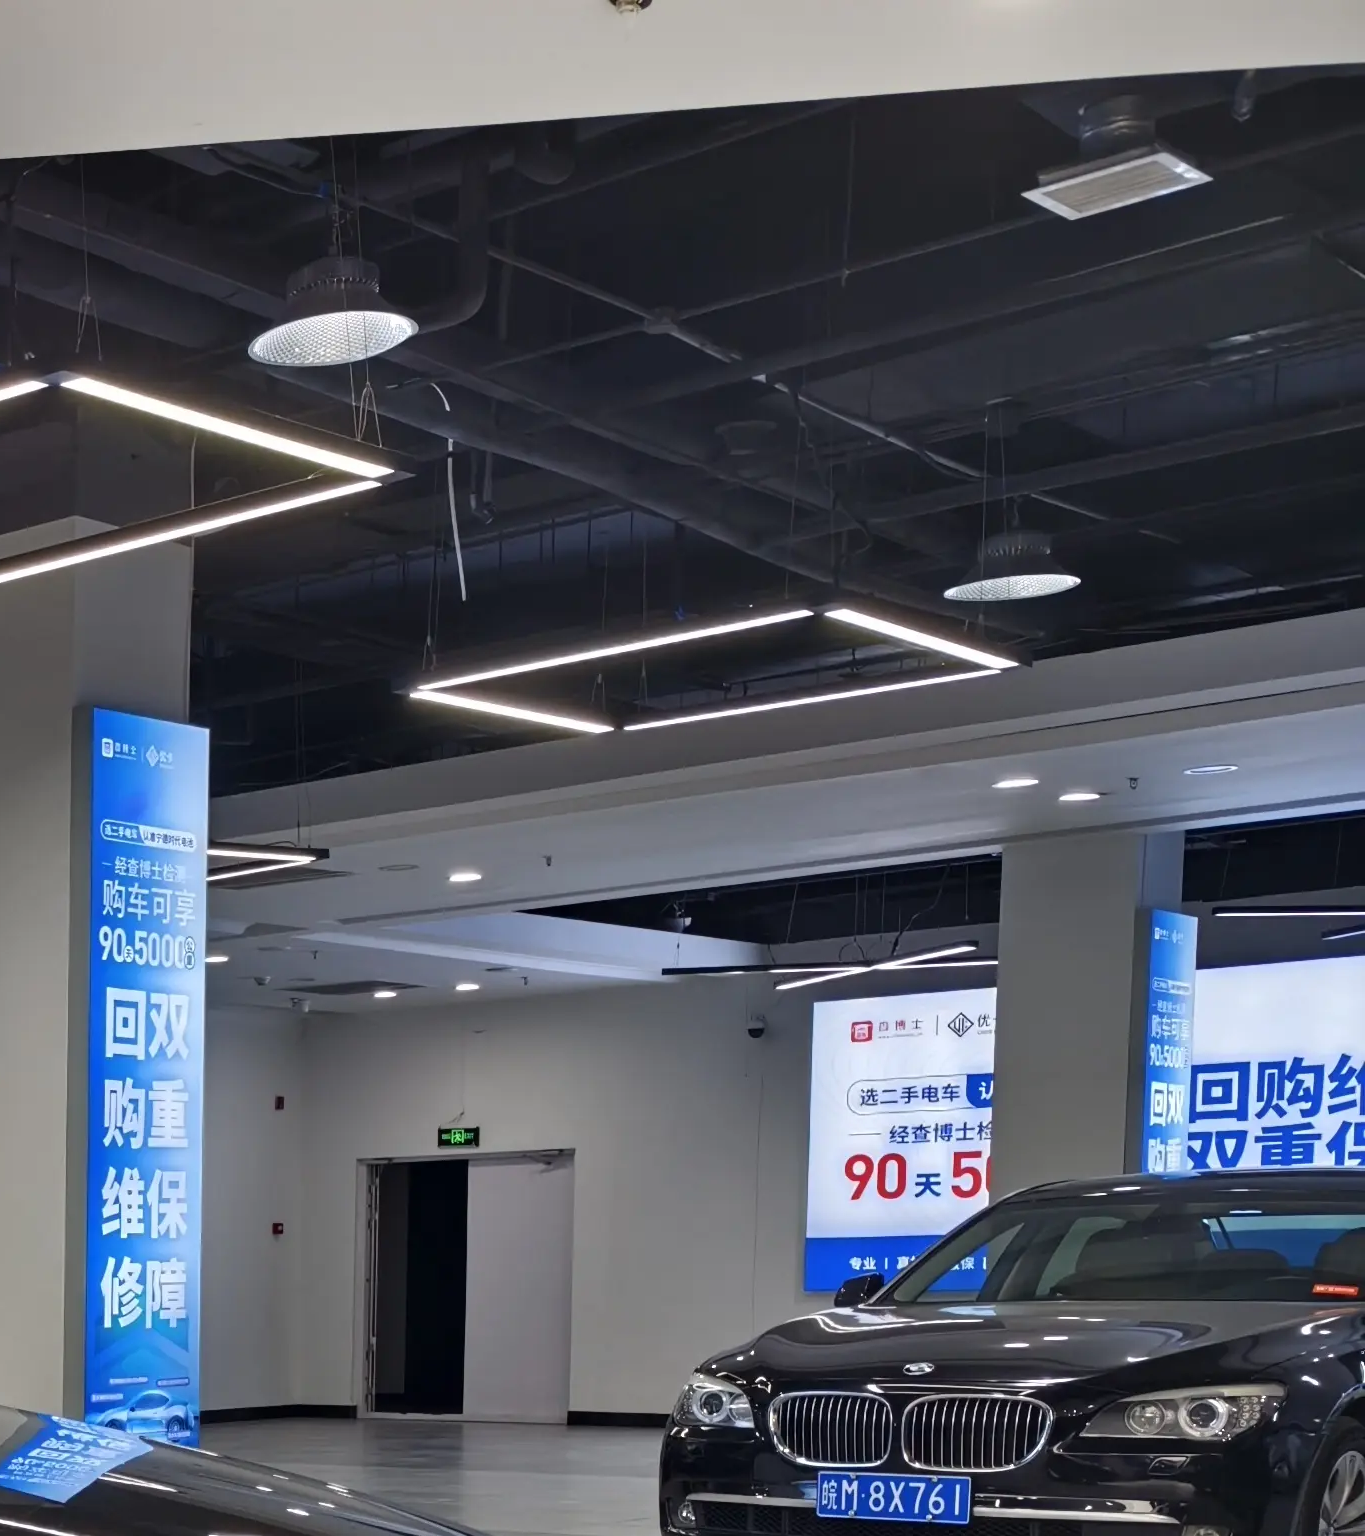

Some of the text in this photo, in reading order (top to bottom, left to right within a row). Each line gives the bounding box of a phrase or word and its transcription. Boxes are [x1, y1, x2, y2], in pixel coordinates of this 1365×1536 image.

[101, 880, 196, 927] 购车可享
[860, 1083, 961, 1107] 选二手电车
